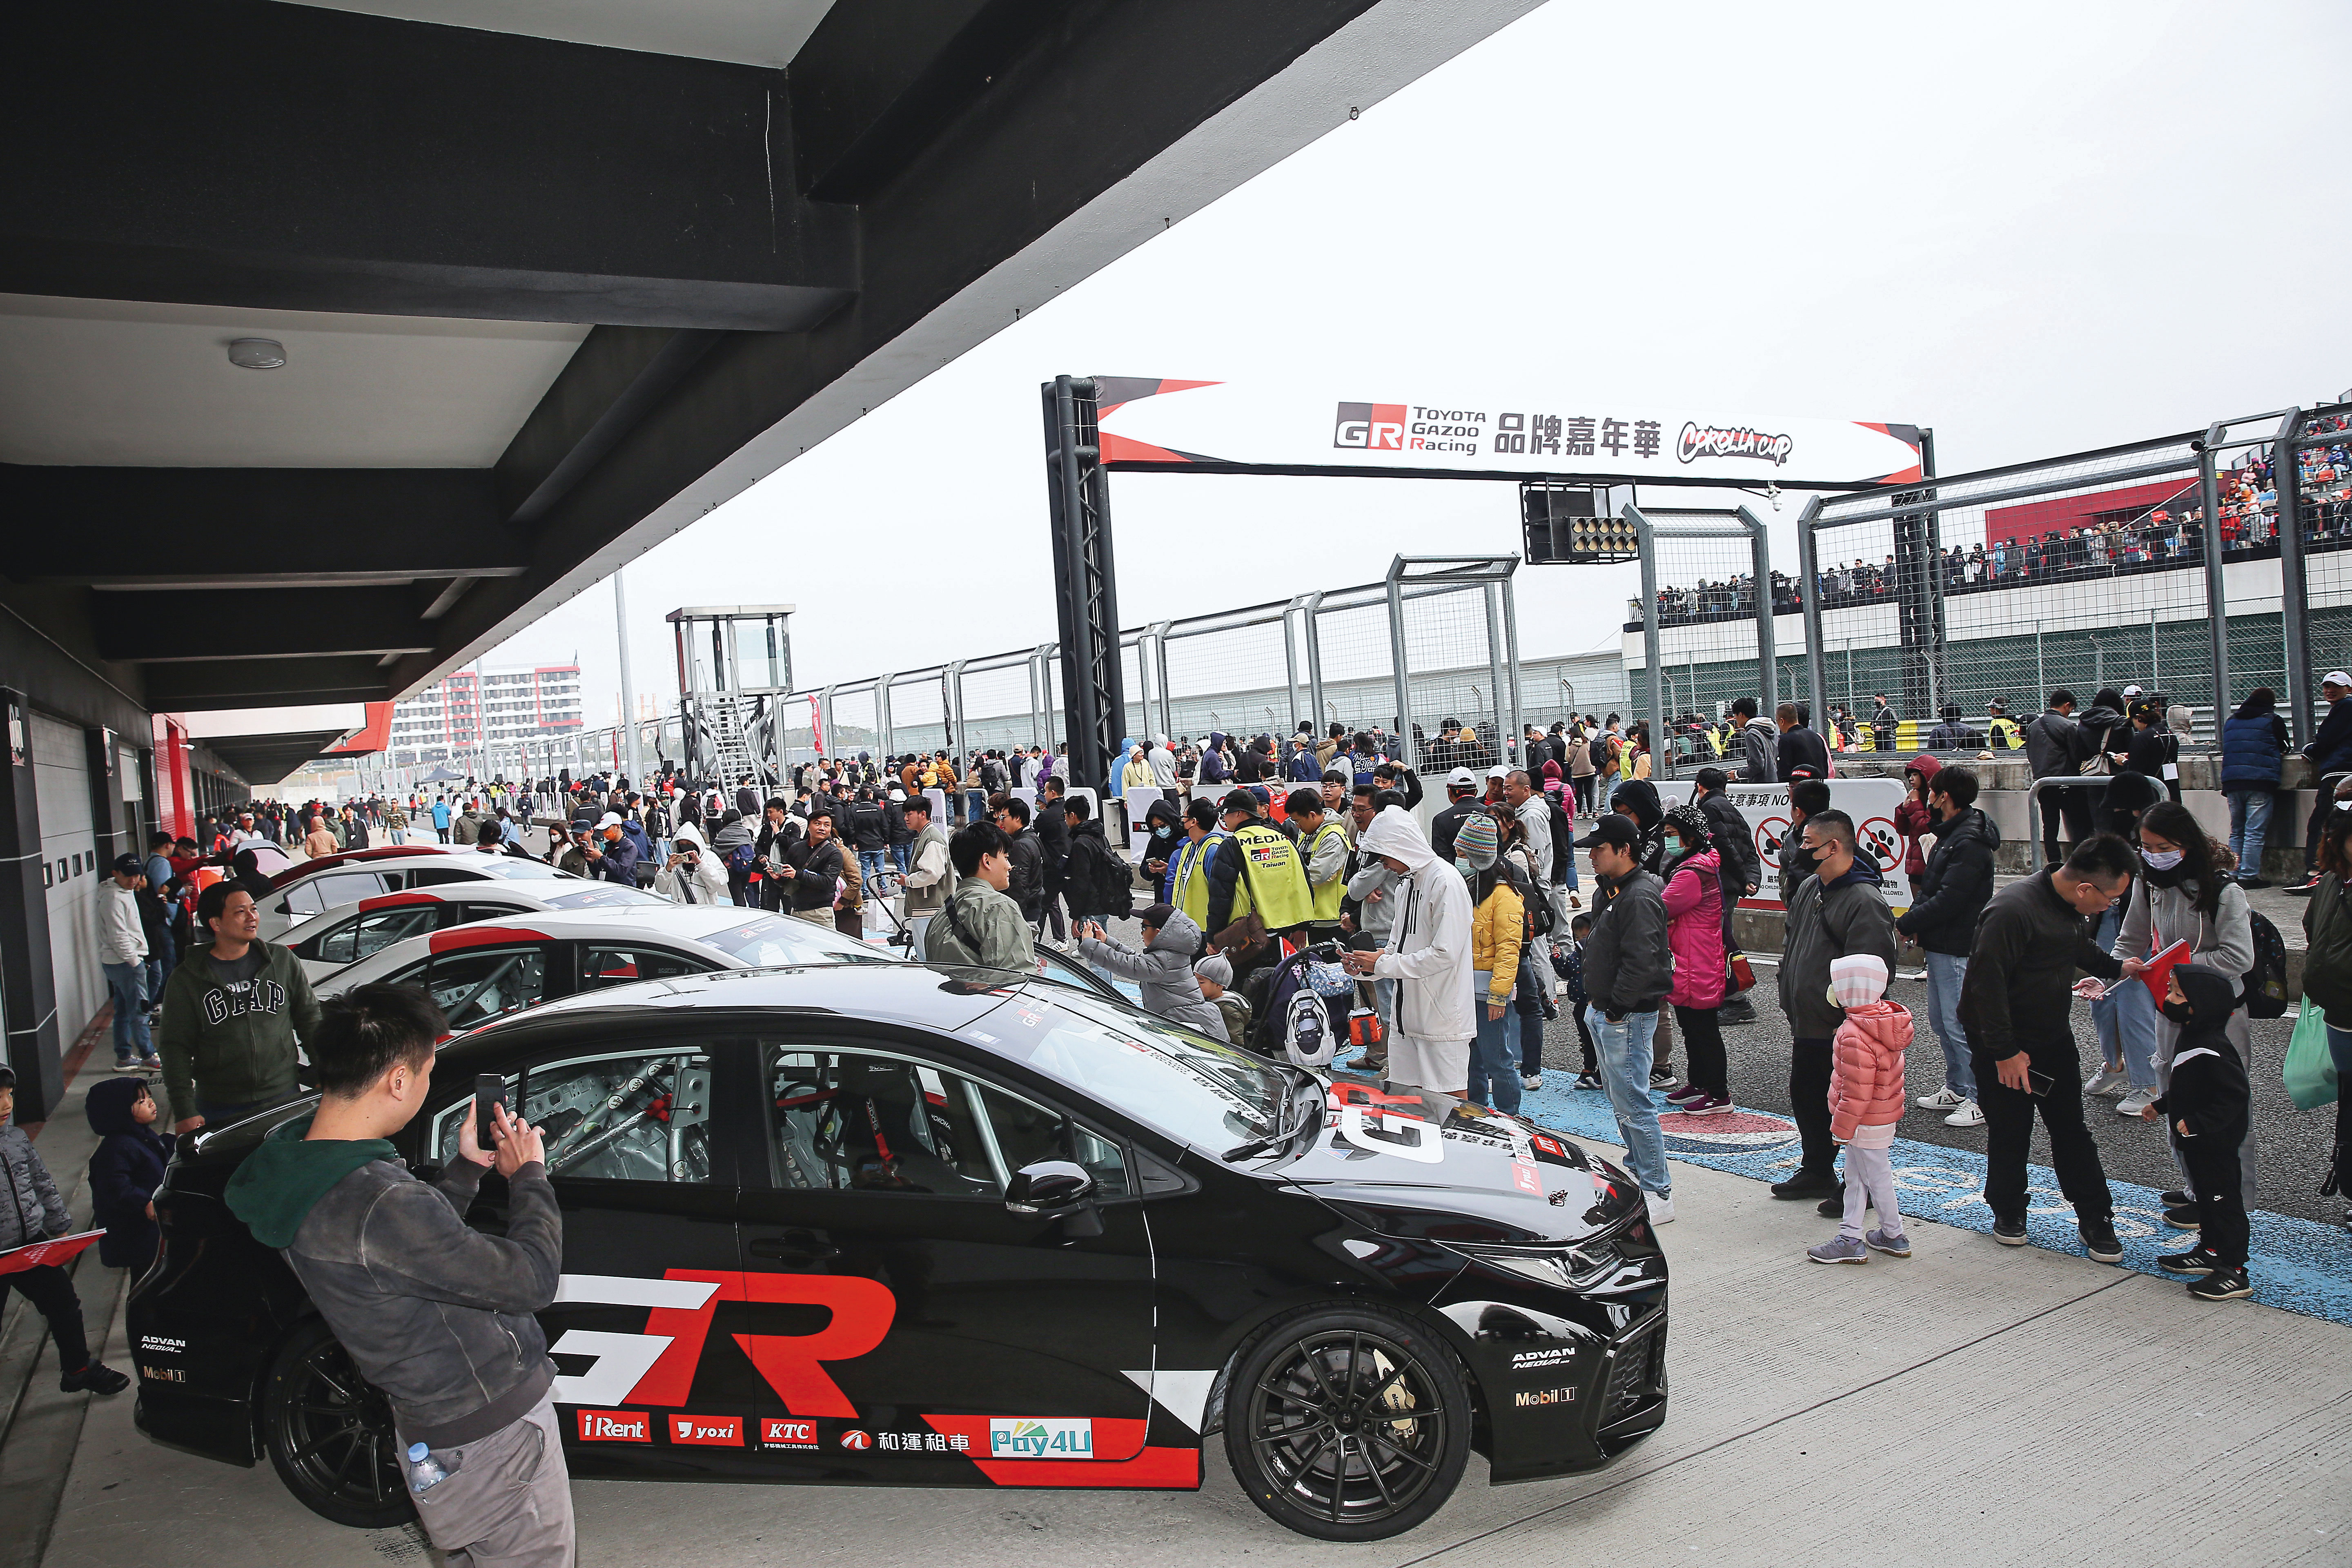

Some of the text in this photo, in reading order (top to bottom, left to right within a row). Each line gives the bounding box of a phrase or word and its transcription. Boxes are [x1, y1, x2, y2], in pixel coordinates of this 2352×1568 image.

[1413, 407, 1486, 422] TOYOTA
[1336, 421, 1403, 448] GR
[1412, 423, 1479, 437] GAZOO
[1495, 413, 1661, 458] 品牌嘉年華
[1410, 438, 1477, 455] Racing
[1677, 422, 1792, 466] COROLLA CUP
[1771, 795, 1789, 806] NO
[1252, 852, 1270, 861] GR
[1881, 880, 1898, 888] 寵物
[741, 931, 759, 939] GR
[203, 979, 285, 1024] GAP
[1034, 1000, 1054, 1014] Taiwan
[1022, 1012, 1042, 1027] GR
[931, 1114, 951, 1130] YOKOHA
[1328, 1082, 1445, 1164] GR
[1537, 1137, 1557, 1153] KTC
[141, 1336, 185, 1347] ADVAN
[141, 1343, 175, 1352] NEOVA
[548, 1268, 896, 1419] GR
[1512, 1348, 1575, 1362] ADVAN
[1512, 1358, 1561, 1369] NEOVA
[144, 1366, 173, 1381] Mobil
[1516, 1389, 1558, 1406] Mobil
[696, 1424, 734, 1439] yoxi
[768, 1424, 810, 1439] KTC
[878, 1432, 970, 1452] 和運租車
[991, 1430, 1091, 1456] Pay4U
